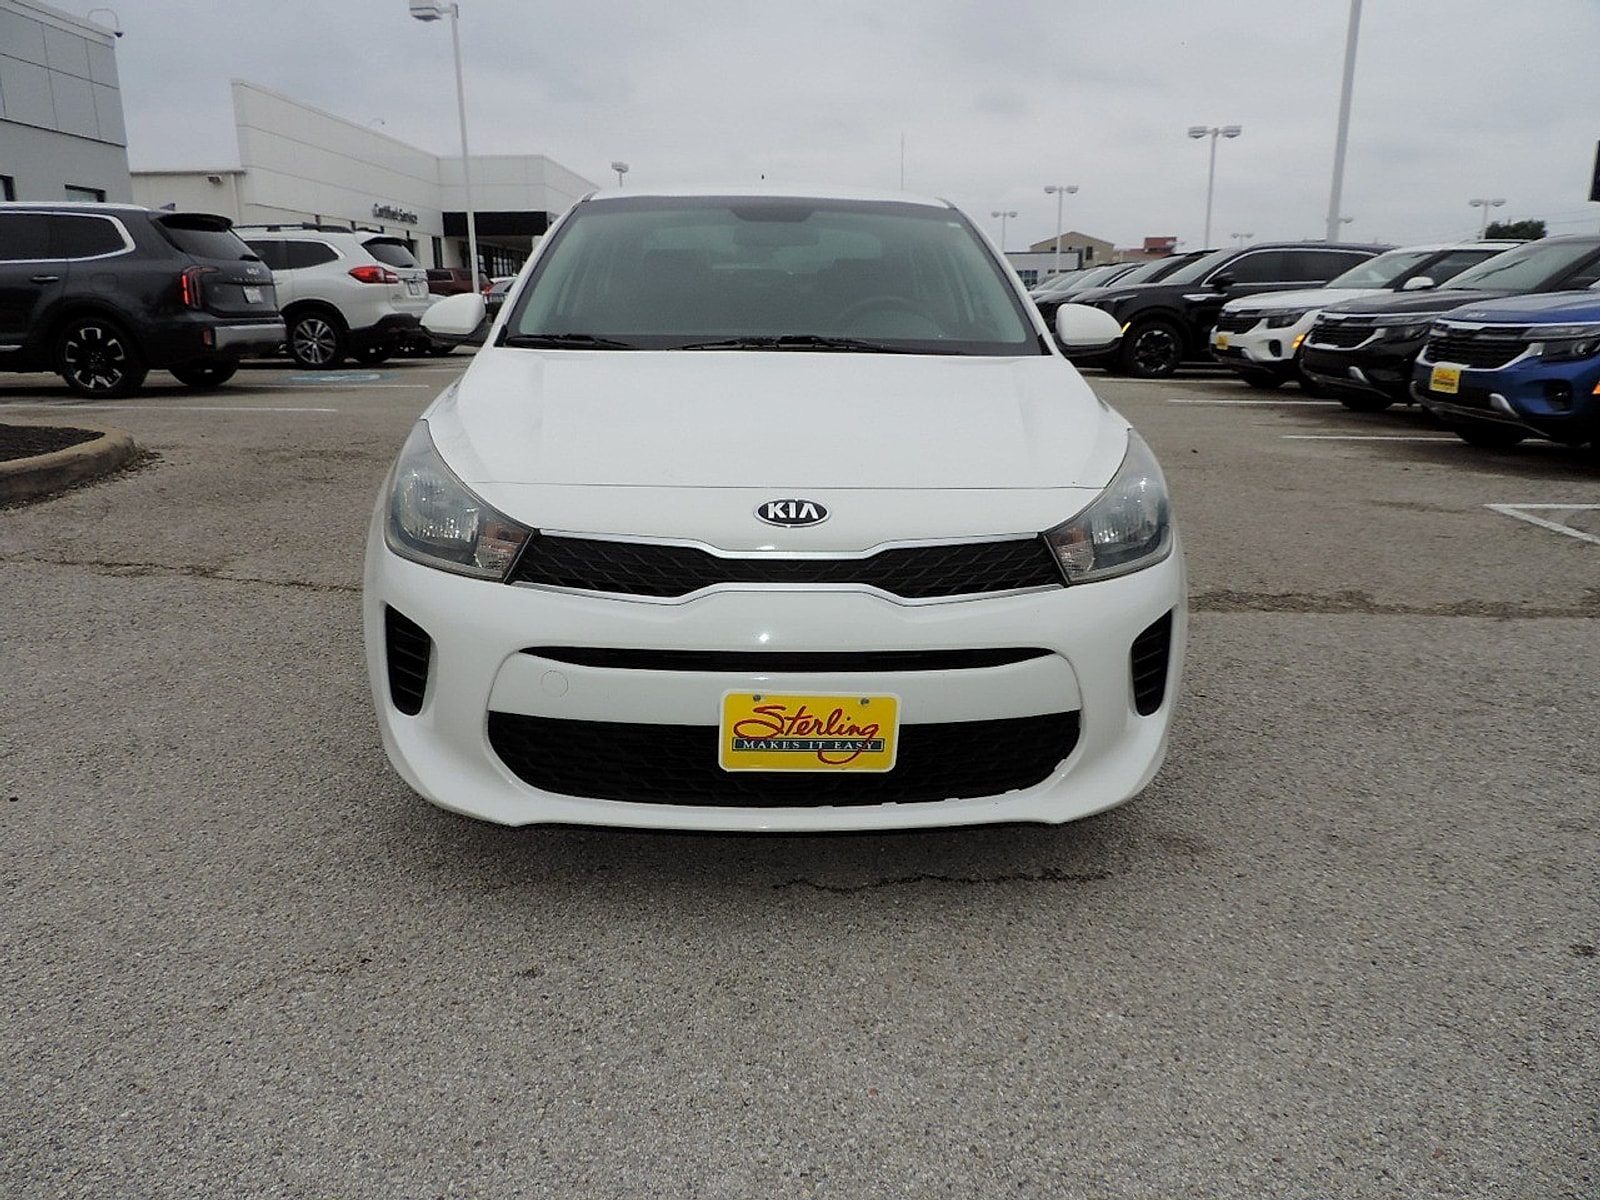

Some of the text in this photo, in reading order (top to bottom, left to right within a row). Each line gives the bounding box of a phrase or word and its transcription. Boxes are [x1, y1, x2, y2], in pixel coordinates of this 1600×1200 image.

[767, 502, 819, 519] KIA
[733, 705, 880, 764] Sterling
[742, 739, 874, 750] MAKES IT EASY
